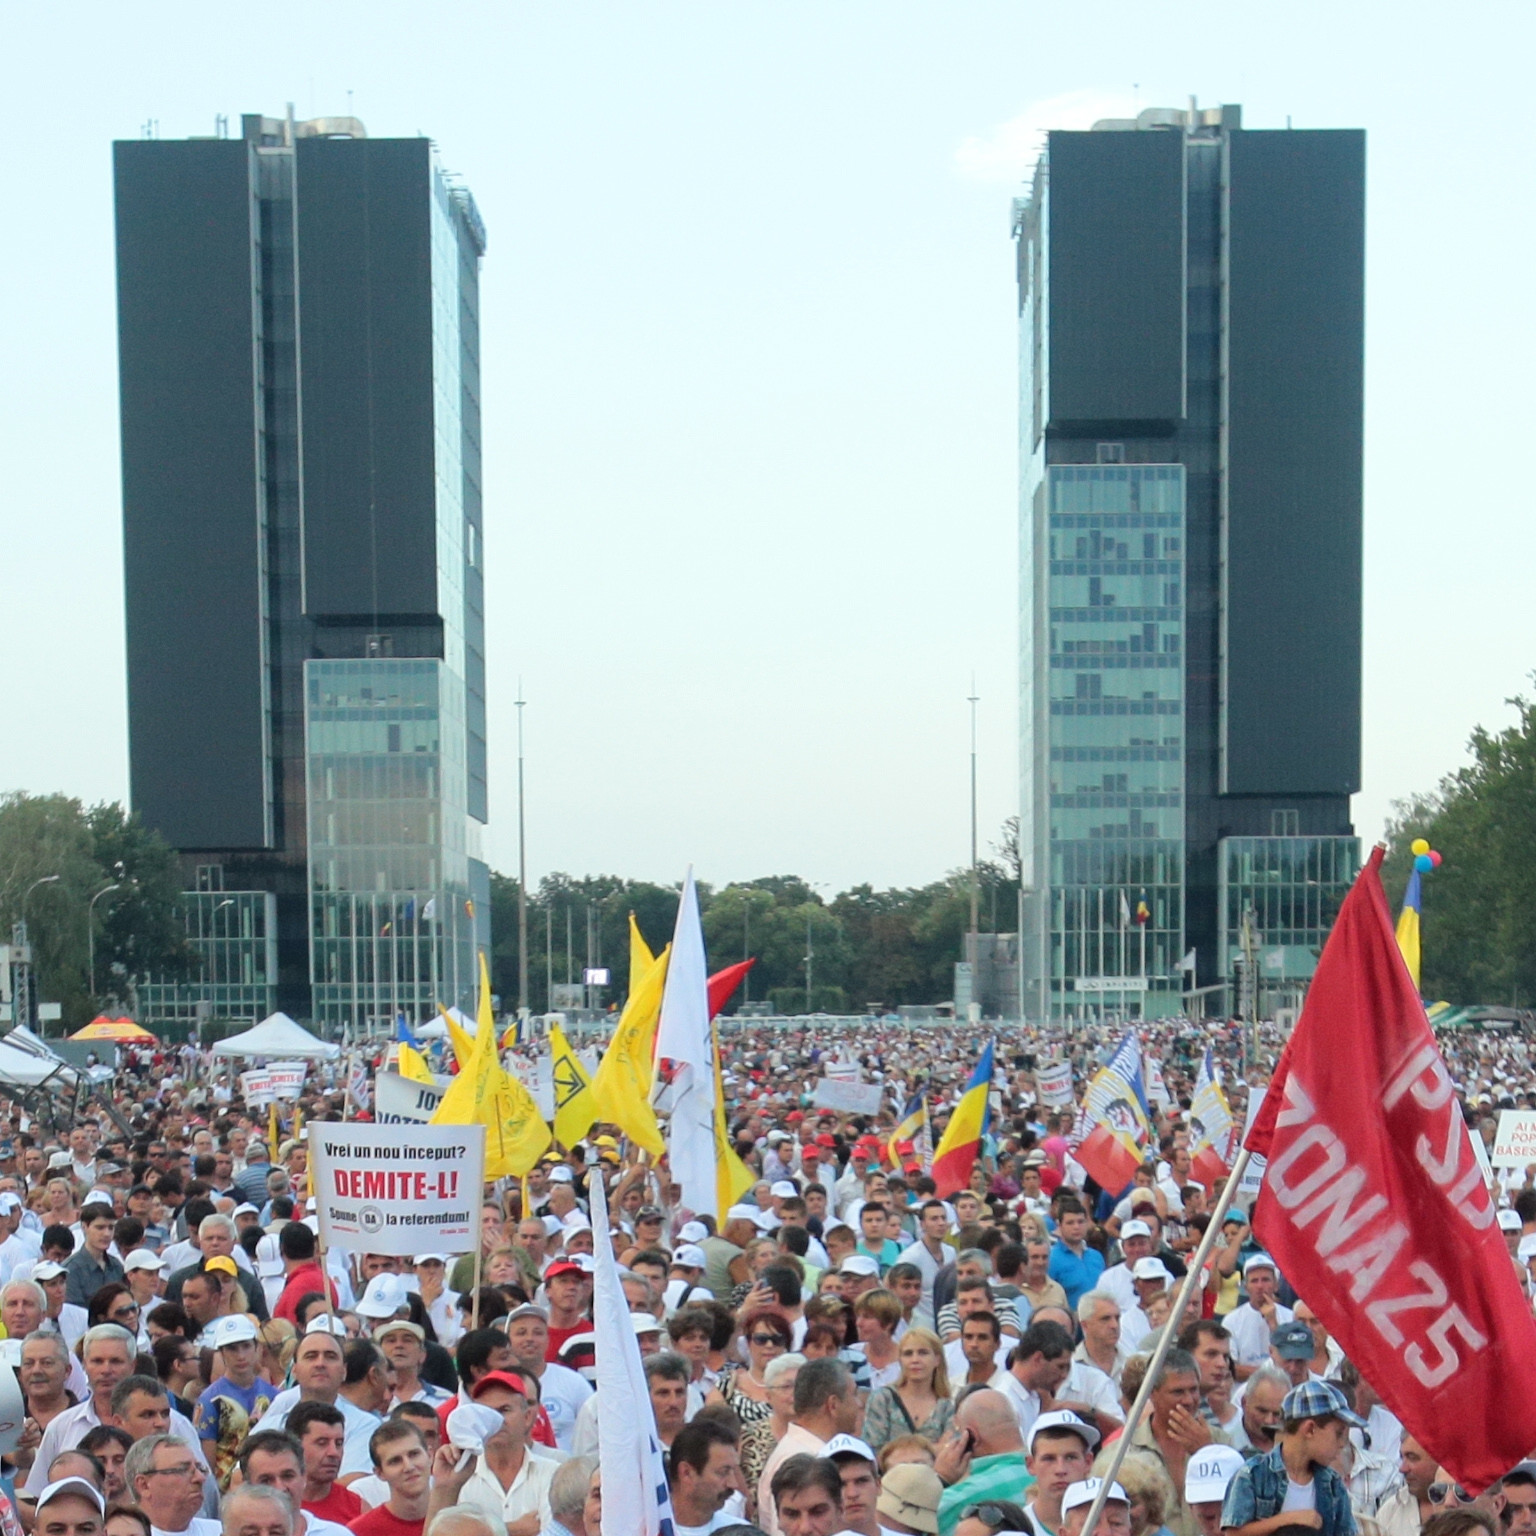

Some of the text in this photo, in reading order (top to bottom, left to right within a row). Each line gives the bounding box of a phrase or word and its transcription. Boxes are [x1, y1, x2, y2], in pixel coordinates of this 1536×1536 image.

[325, 1142, 351, 1158] Vrei
[354, 1145, 371, 1158] un
[374, 1146, 400, 1159] nou
[334, 1169, 458, 1200] DEMITE-L!
[365, 1214, 376, 1224] DA
[386, 1213, 397, 1225] la
[400, 1211, 470, 1226] referendum!
[829, 1437, 852, 1451] DA
[1200, 1462, 1222, 1478] DA
